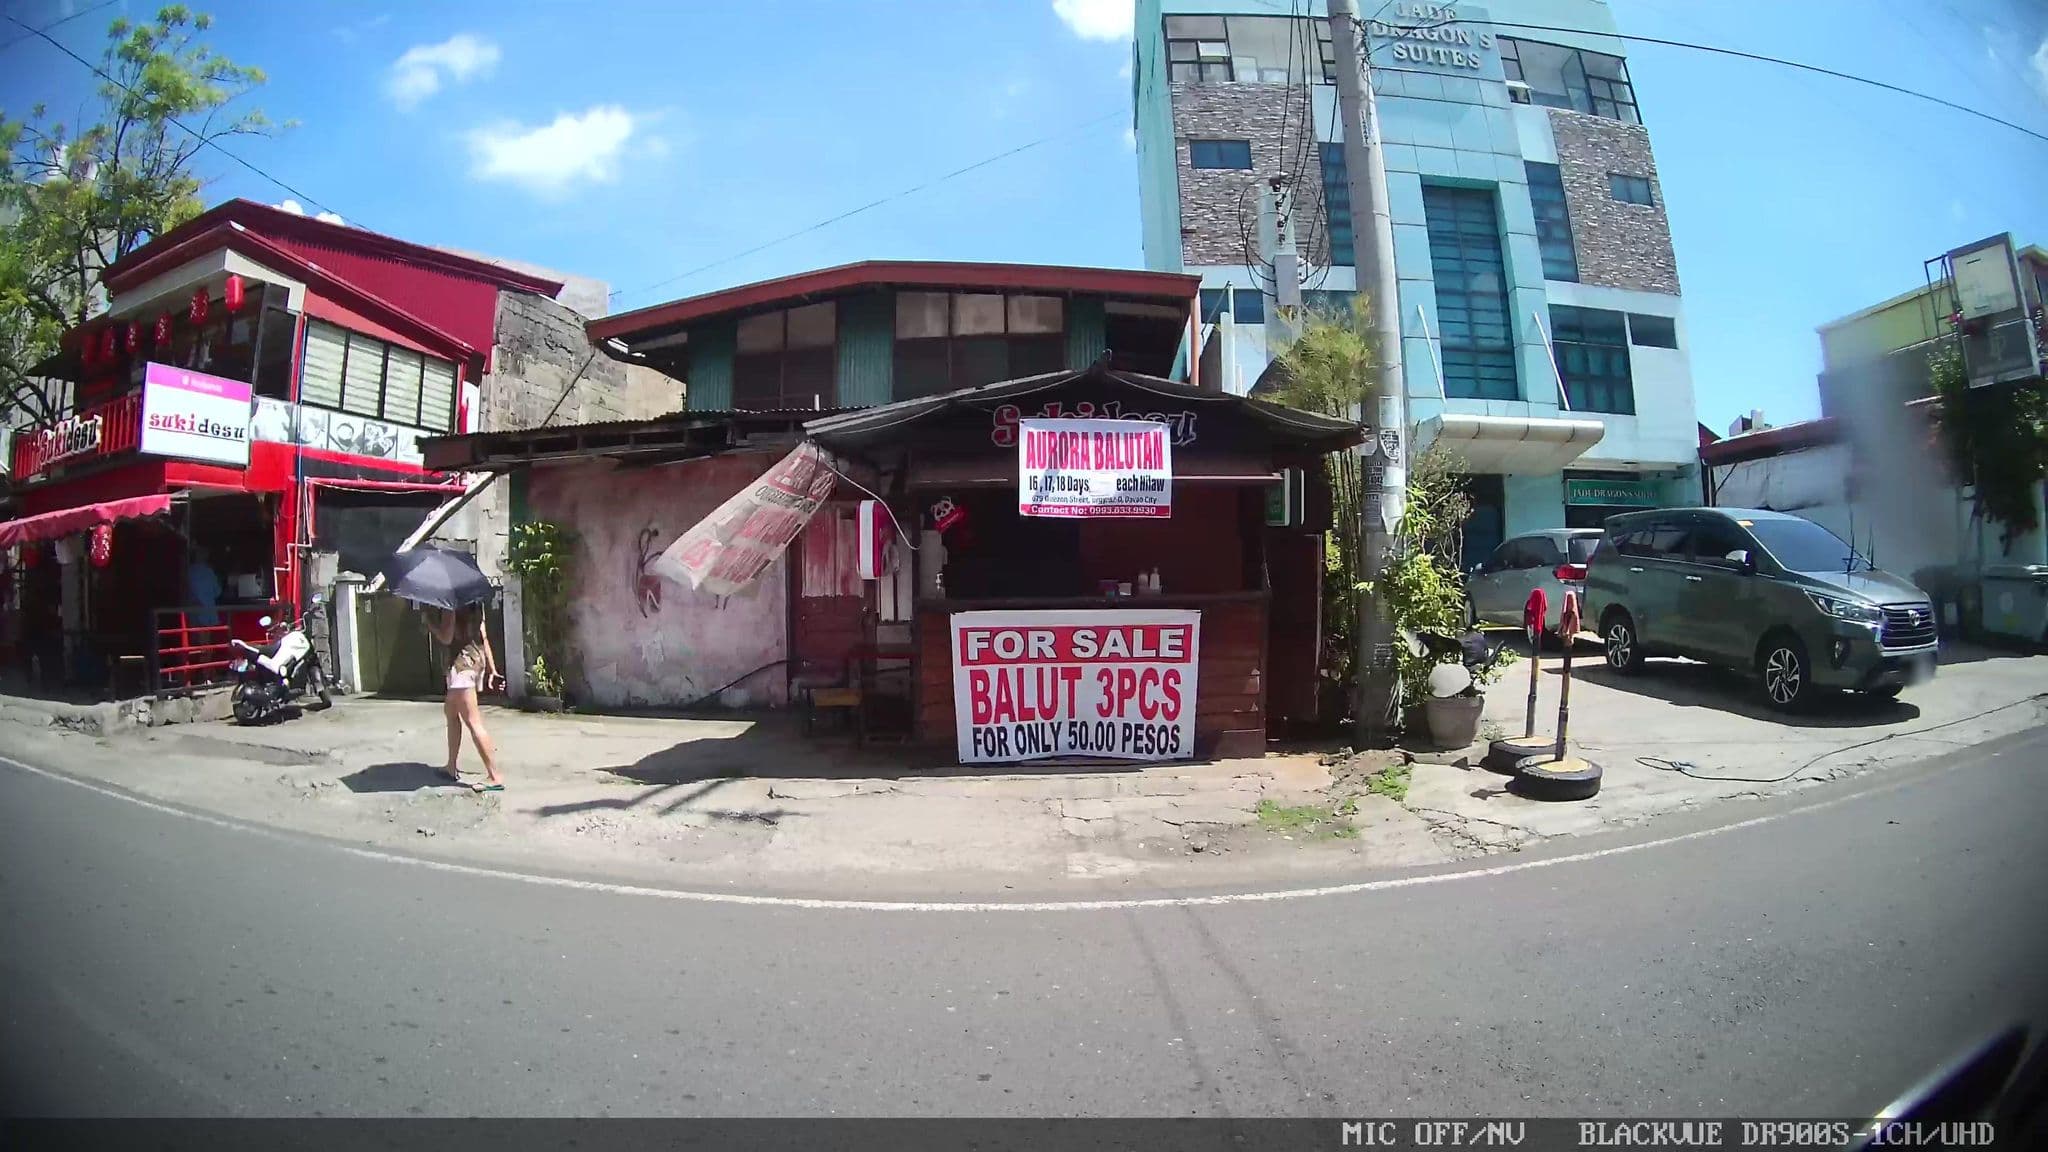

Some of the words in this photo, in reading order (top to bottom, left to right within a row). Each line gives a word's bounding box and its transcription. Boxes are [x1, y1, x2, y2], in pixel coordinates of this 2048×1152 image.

[1393, 41, 1481, 69] SUITES
[149, 413, 245, 439] sukidesu
[1026, 431, 1091, 470] AURORA
[1094, 431, 1164, 470] BALUTAN
[1056, 475, 1066, 491] 18
[1067, 475, 1090, 495] Days
[1116, 475, 1140, 492] each
[1140, 475, 1165, 492] Hilaw
[1031, 505, 1069, 515] Contact
[1072, 506, 1087, 515] No:
[967, 630, 1057, 661] FOR
[1072, 628, 1185, 659] SALE
[970, 667, 1082, 724] BALUT
[1096, 667, 1181, 721] 3PCS
[972, 726, 1010, 757] FOR
[1014, 721, 1062, 755] ONLY
[1068, 721, 1116, 752] 50.00
[1121, 722, 1180, 755] PESOS
